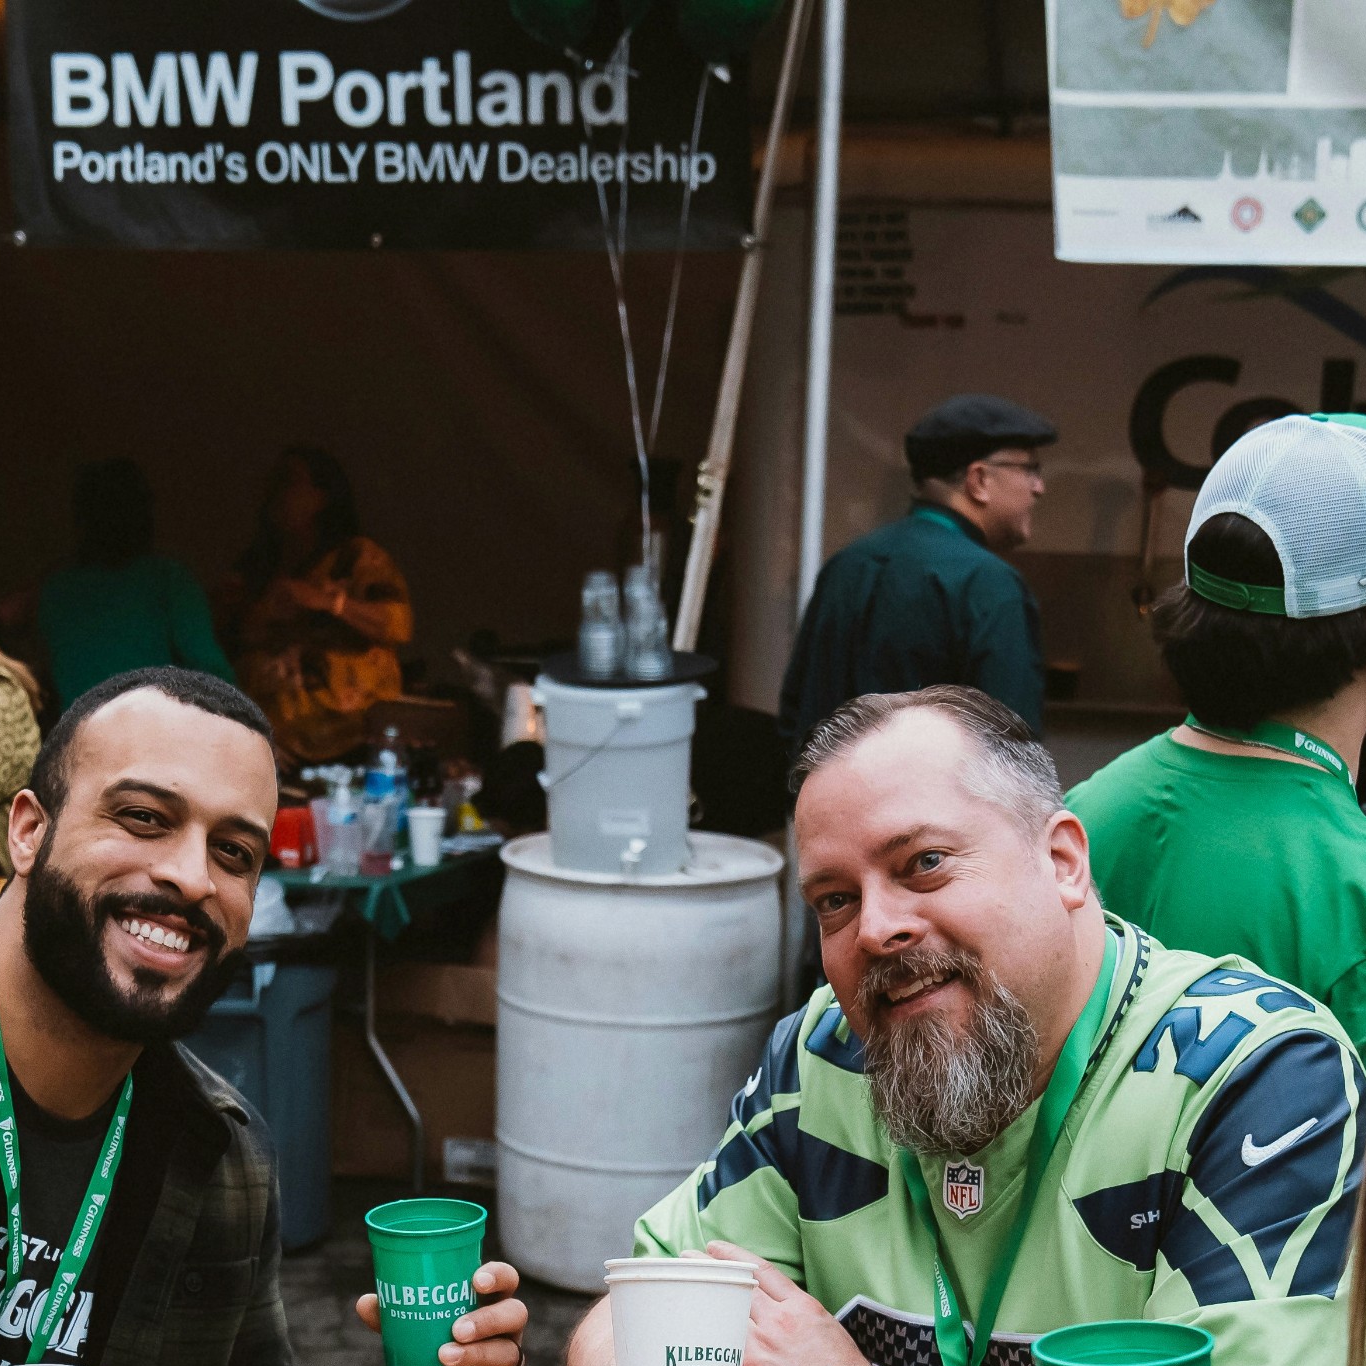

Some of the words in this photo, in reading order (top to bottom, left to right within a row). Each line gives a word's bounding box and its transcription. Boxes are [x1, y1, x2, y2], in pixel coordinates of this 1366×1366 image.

[50, 52, 259, 128] BMW
[280, 50, 628, 128] Portland
[53, 142, 248, 184] Portland's
[256, 142, 368, 185] ONLY
[375, 143, 489, 184] BMW
[498, 143, 717, 190] Dealership
[1, 1130, 18, 1190] GUINNESS
[100, 1126, 122, 1179] GUINNESS
[949, 1184, 978, 1209] NFL
[11, 1217, 21, 1276] GUINNESS
[72, 1203, 99, 1258] GUINNESS
[41, 1282, 69, 1336] GUINNESS
[376, 1278, 477, 1309] KILBEGGAN
[390, 1308, 451, 1321] DISTILLING
[934, 1260, 952, 1318] GUINNESS
